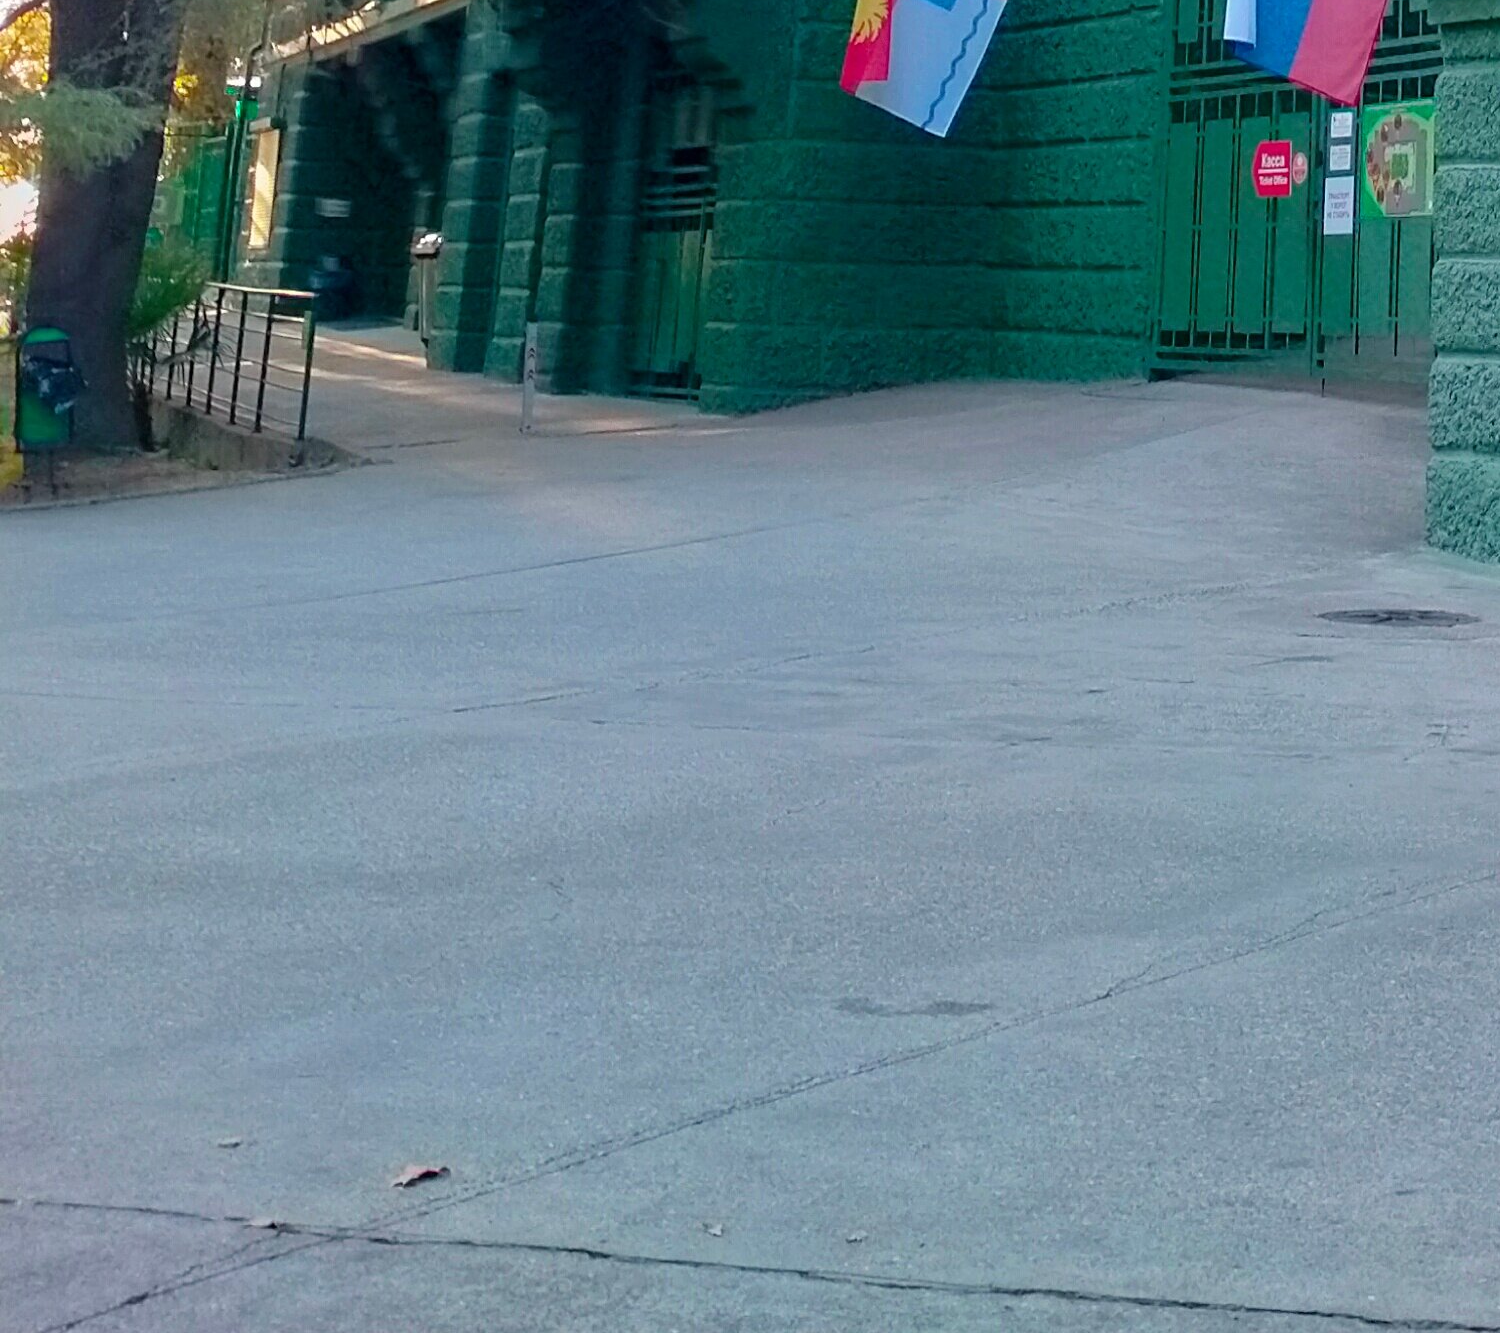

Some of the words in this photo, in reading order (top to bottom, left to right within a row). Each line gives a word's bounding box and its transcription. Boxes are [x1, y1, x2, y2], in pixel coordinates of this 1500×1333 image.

[1261, 153, 1285, 168] Касса
[1258, 175, 1273, 186] Ticket
[1273, 174, 1288, 185] Office
